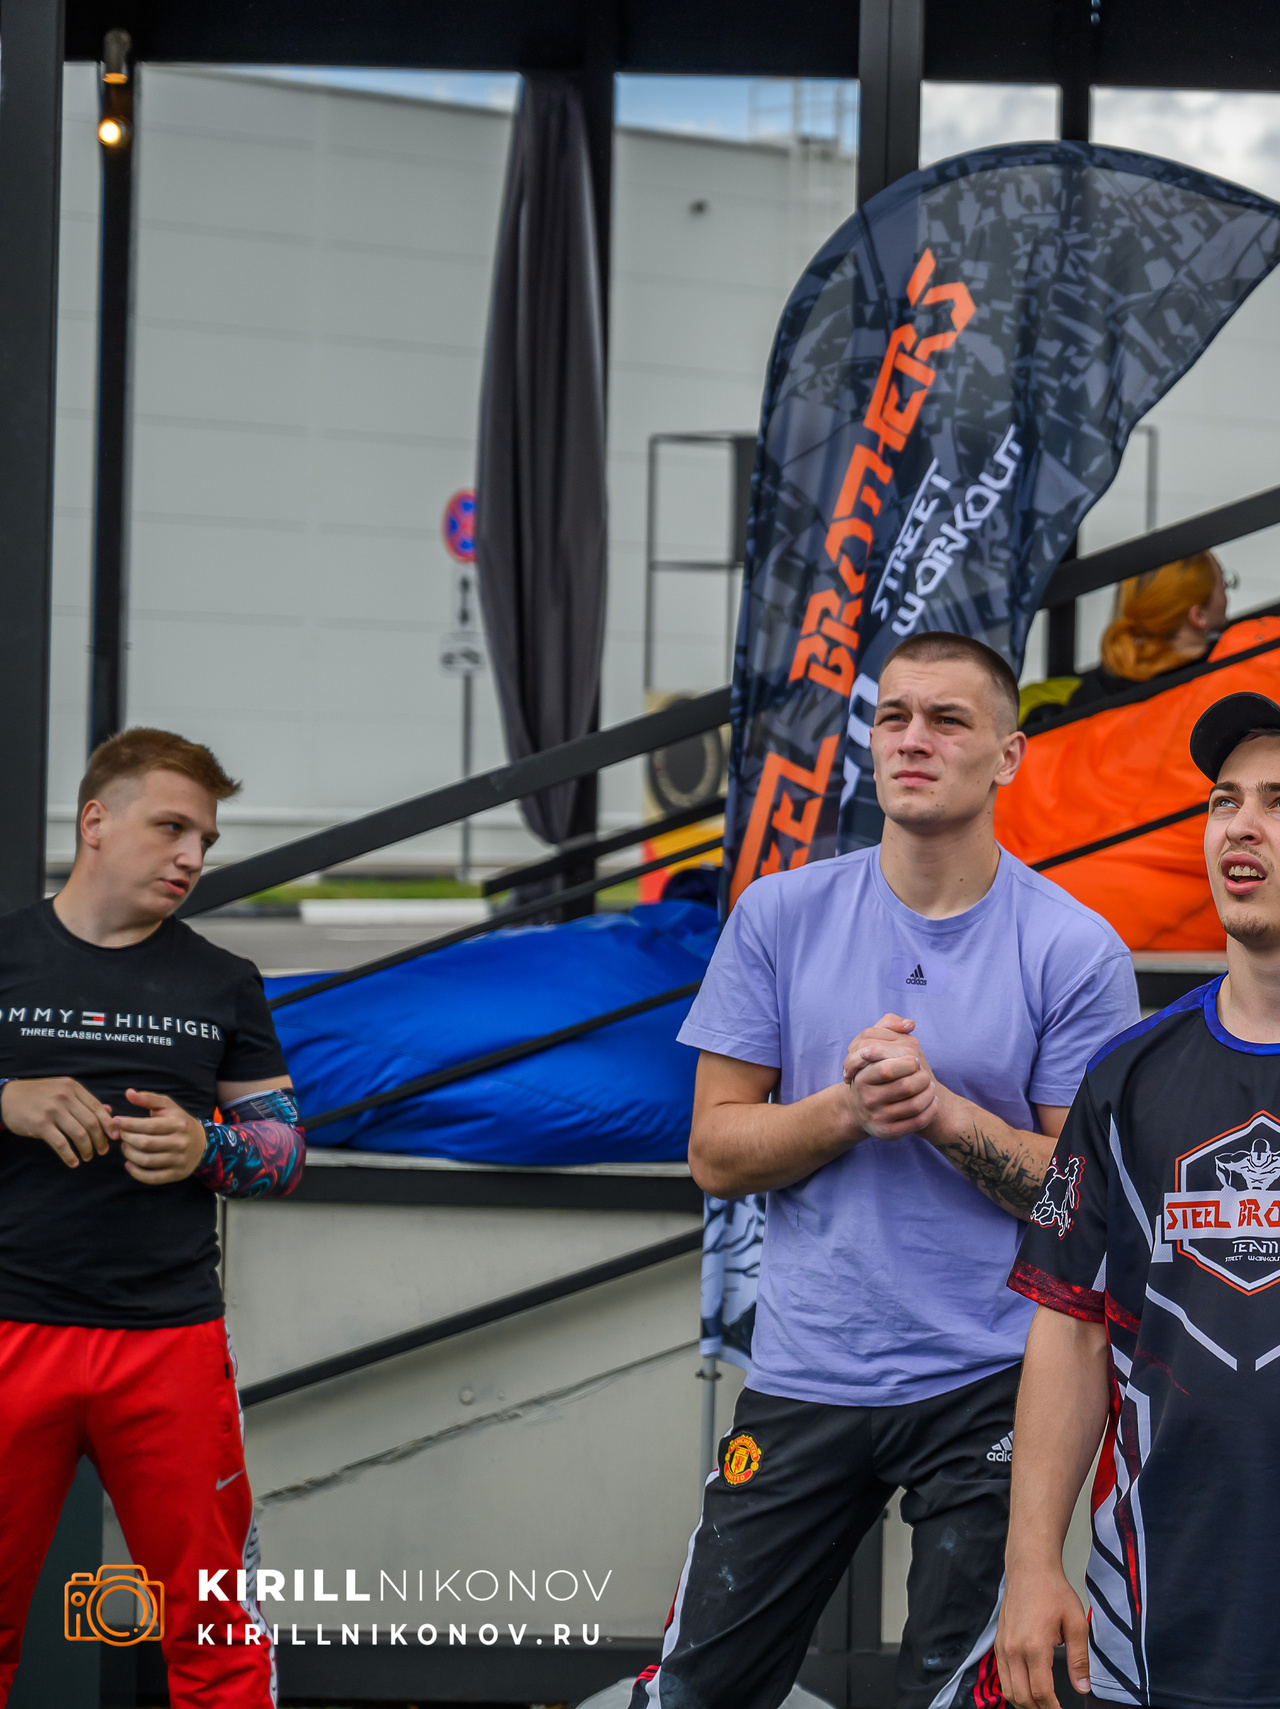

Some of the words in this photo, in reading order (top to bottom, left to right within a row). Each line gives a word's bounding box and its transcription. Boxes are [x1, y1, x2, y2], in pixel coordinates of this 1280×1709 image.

[788, 247, 977, 698] BROTHERS
[870, 456, 951, 622] STREET
[891, 422, 1022, 637] WORKOUT
[0, 1006, 73, 1023] MMY
[116, 1012, 222, 1041] HILFIGER
[20, 1027, 55, 1038] THREE
[57, 1029, 102, 1042] CLASSIC
[104, 1033, 144, 1043] V-NECK
[146, 1035, 172, 1047] TEES
[1165, 1200, 1231, 1230] STEEL
[1232, 1239, 1279, 1254] TEAM
